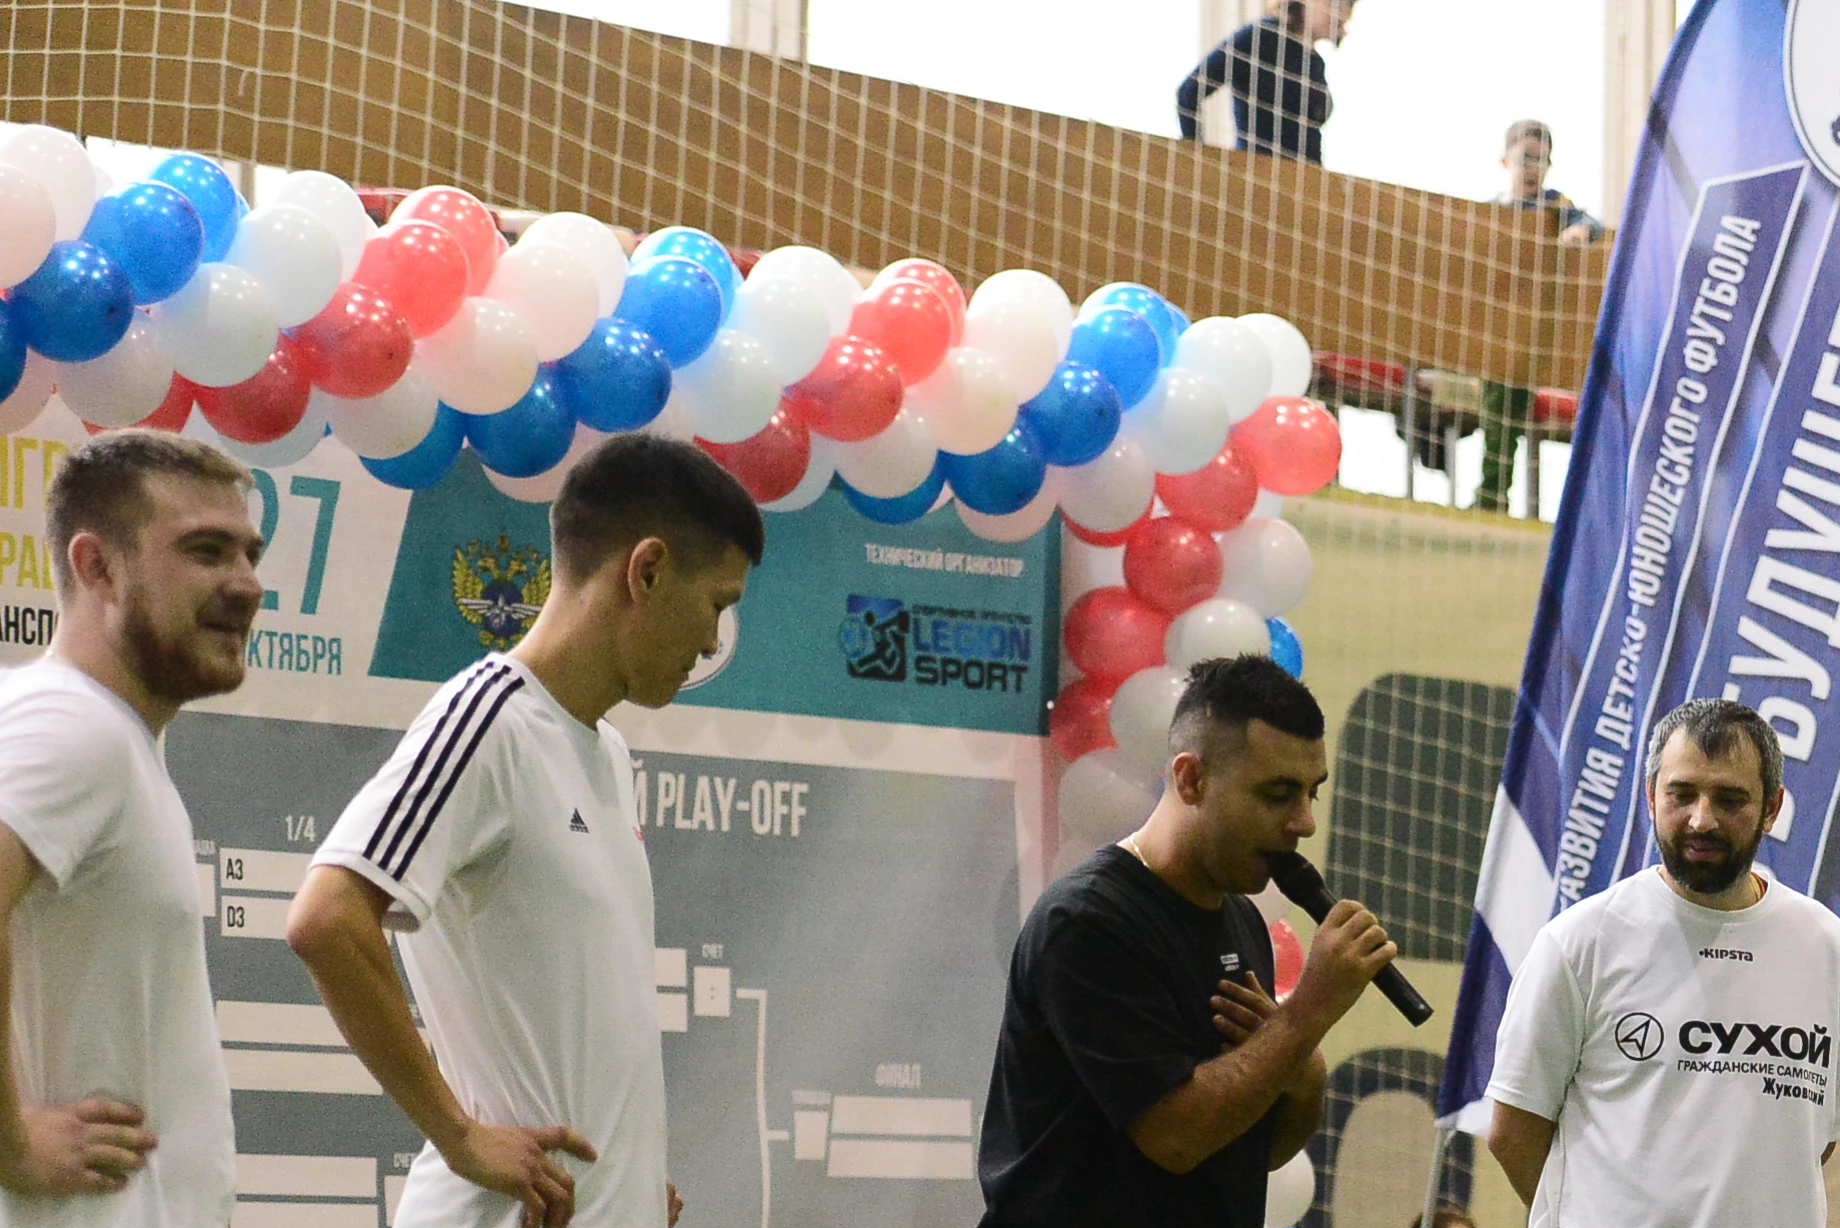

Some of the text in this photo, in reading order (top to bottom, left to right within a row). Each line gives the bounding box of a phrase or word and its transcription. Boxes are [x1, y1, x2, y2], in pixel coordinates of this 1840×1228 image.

[1595, 378, 1709, 751] ДЕТСКО-ЮНОШЕСКОГО
[1682, 214, 1762, 375] ФУТБОЛА
[246, 628, 342, 676] КТЯБРЯ
[912, 616, 1032, 662] LEGION
[914, 655, 1029, 693] SPORT
[656, 770, 809, 838] PLAY-OFF
[285, 814, 316, 842] 1/4
[226, 905, 245, 928] D3
[1677, 1059, 1775, 1075] ГРАЖДАНСКИЕ
[1678, 1019, 1832, 1069] СУХОЙ
